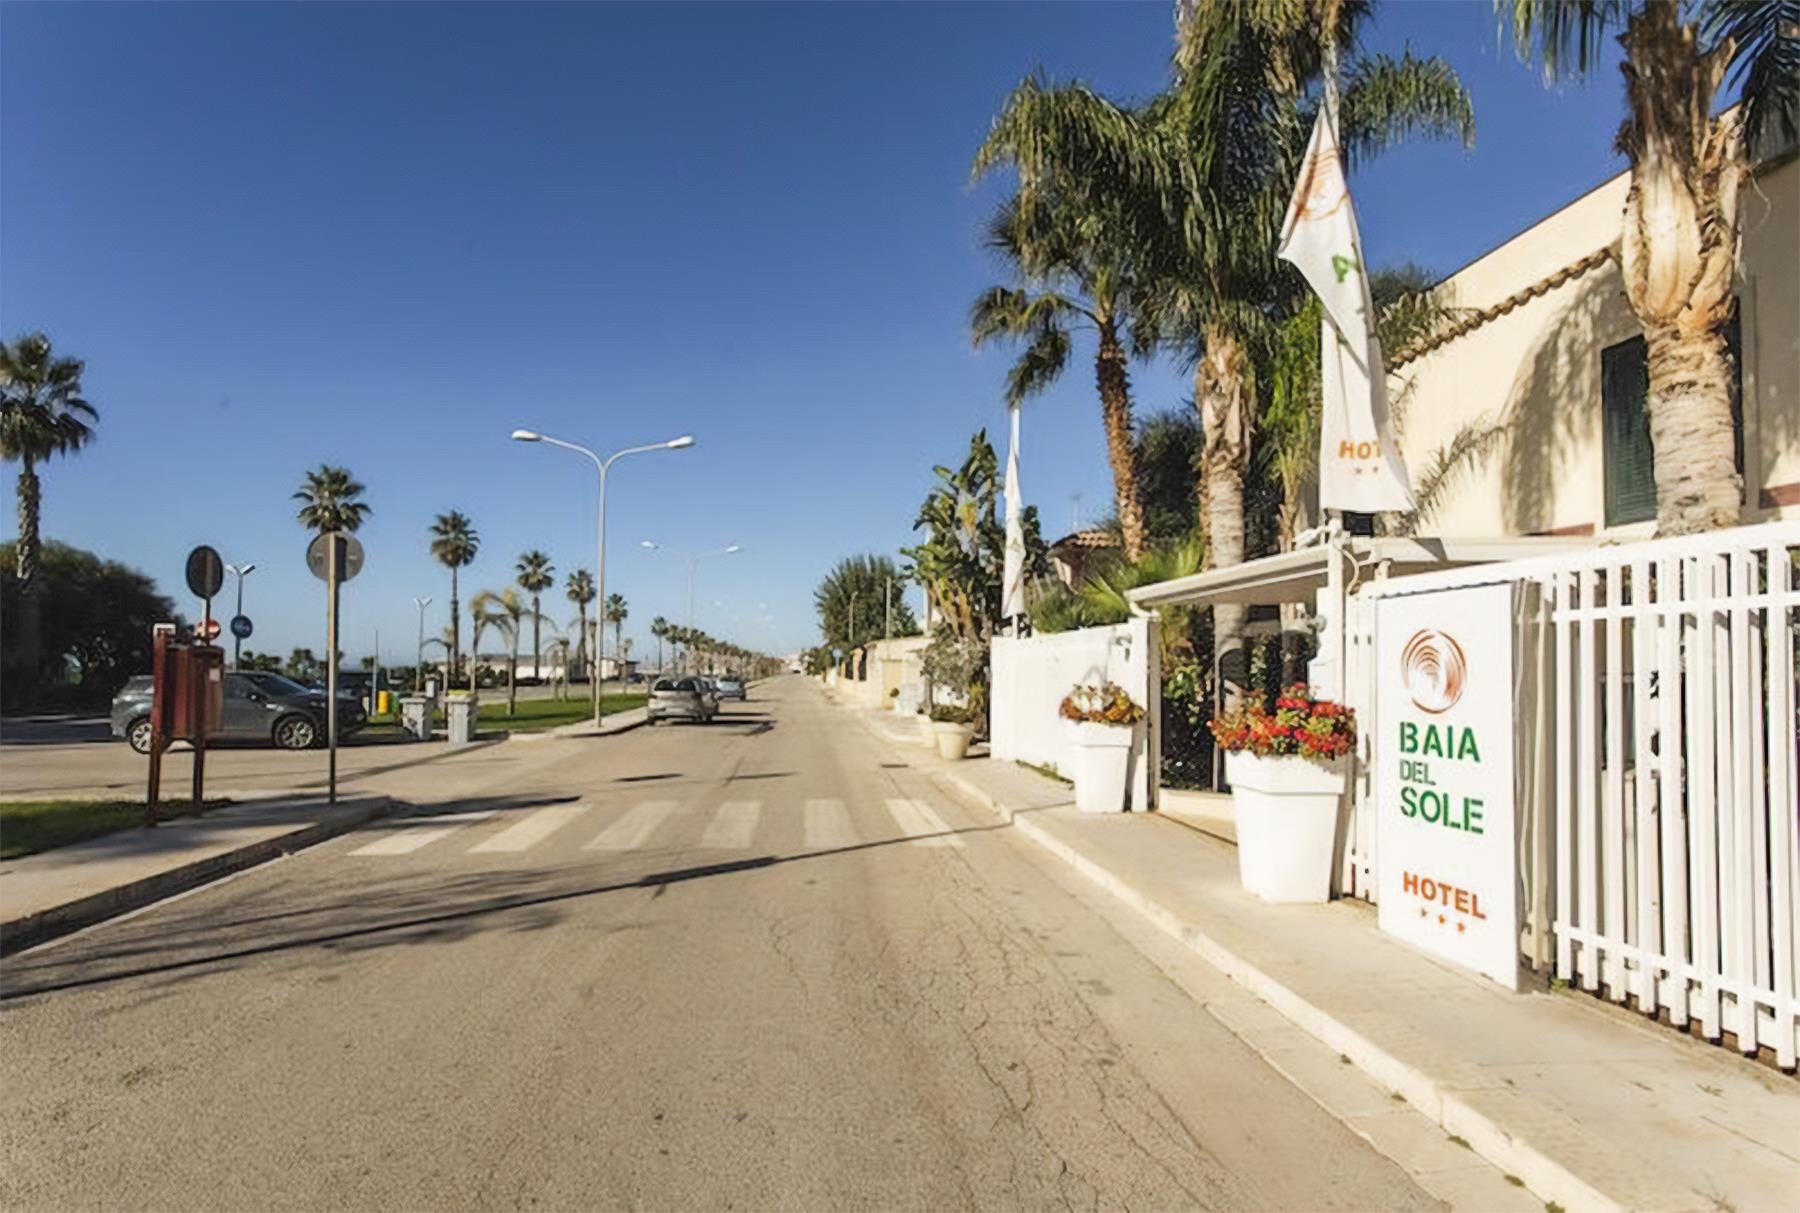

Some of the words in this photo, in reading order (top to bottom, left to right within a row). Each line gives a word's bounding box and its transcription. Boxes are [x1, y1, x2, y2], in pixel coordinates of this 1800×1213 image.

[1339, 439, 1383, 460] HOT
[1400, 721, 1480, 763] BAIA
[1400, 759, 1436, 786] DEL
[1400, 786, 1484, 834] SOLE
[1403, 871, 1487, 920] HOTEL
